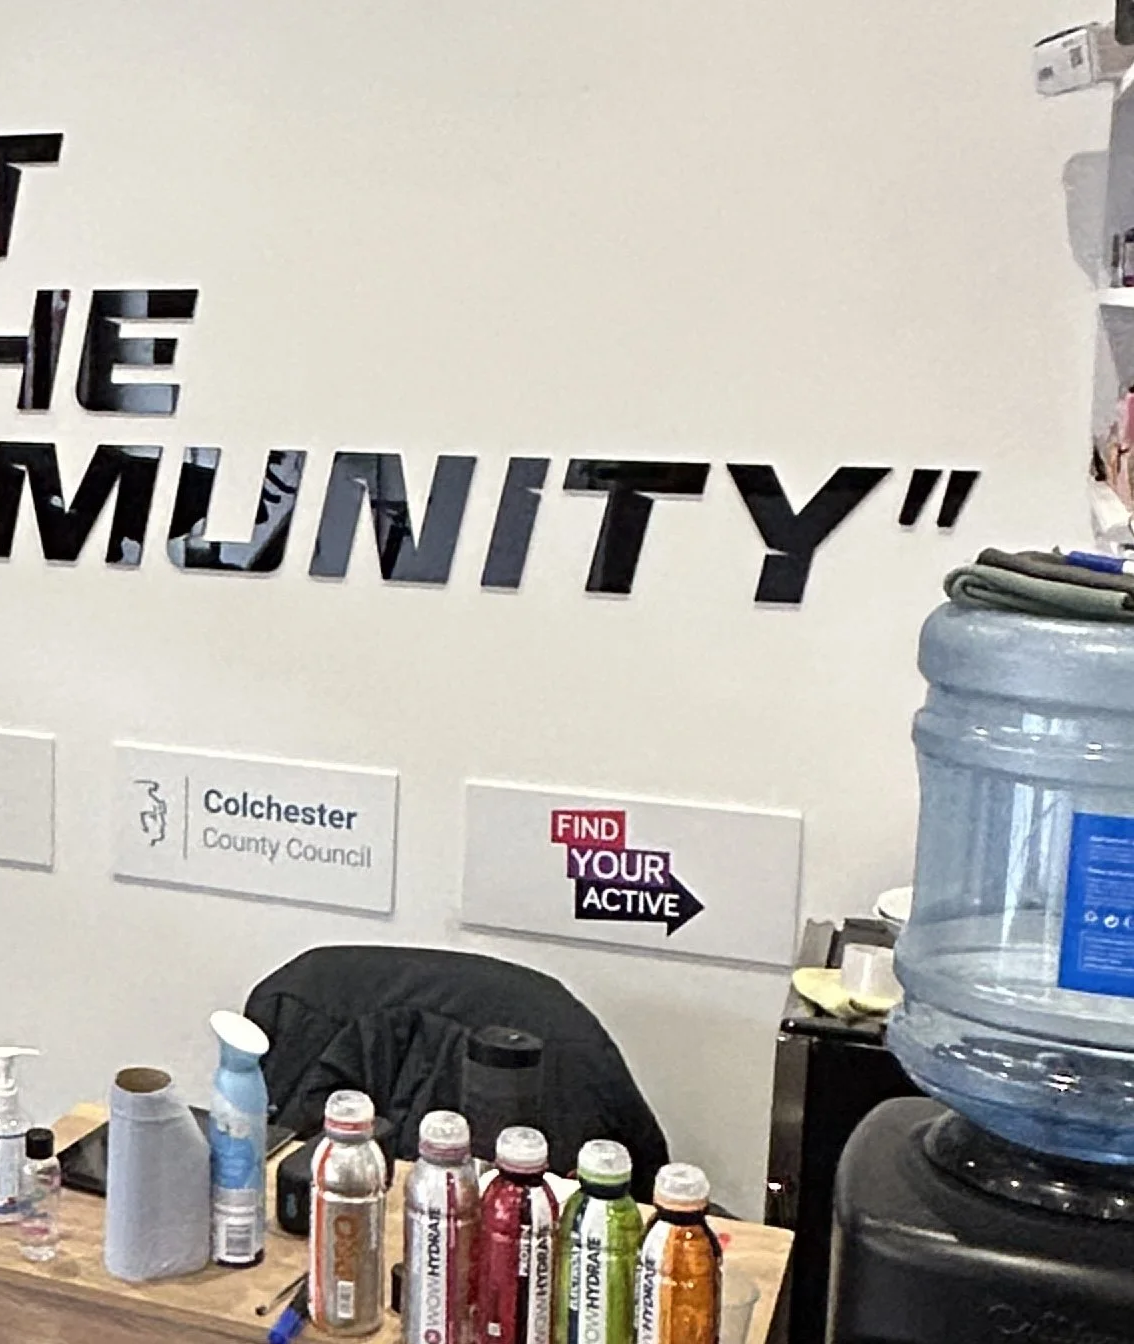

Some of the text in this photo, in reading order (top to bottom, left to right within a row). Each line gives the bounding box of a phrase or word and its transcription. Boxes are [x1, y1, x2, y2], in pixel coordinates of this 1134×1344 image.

[203, 789, 358, 830] Colchester
[557, 815, 619, 841] FIND
[202, 826, 372, 868] County Council
[571, 848, 664, 883] YOUR
[582, 887, 680, 917] ACTIVE
